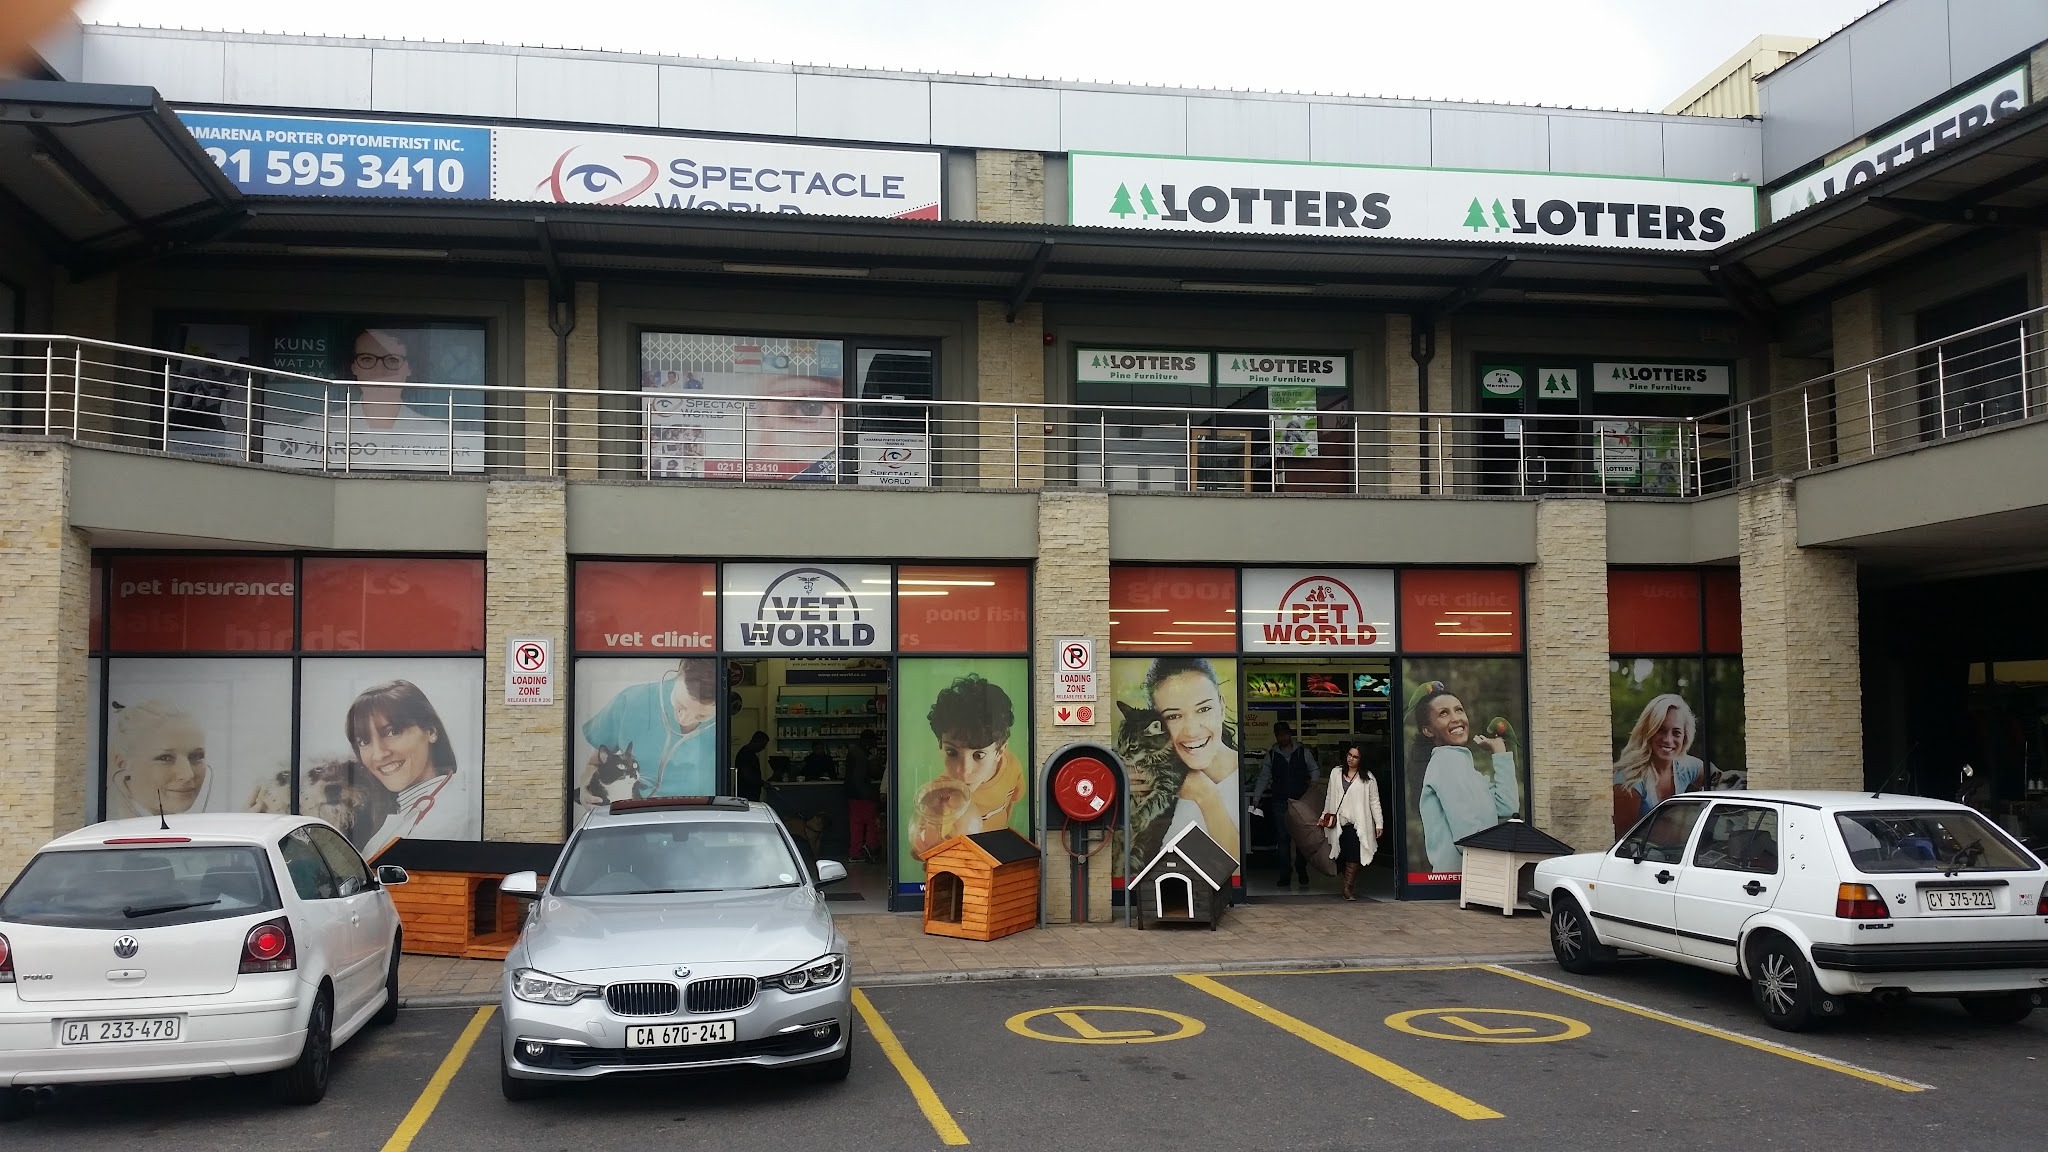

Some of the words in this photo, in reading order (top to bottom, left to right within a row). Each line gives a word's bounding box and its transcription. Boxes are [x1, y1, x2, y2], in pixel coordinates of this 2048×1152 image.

[266, 130, 323, 146] PORTER
[326, 134, 431, 151] OPTOMETRIST
[433, 138, 465, 152] INC.
[266, 150, 345, 188] 595
[356, 154, 465, 193] 3410
[668, 158, 906, 200] SPECTACLE
[1161, 183, 1392, 230] LOTTERS
[1511, 198, 1726, 243] LOTTERS
[274, 337, 326, 351] KUNS
[273, 358, 304, 368] WAT
[308, 359, 325, 369] JY
[1110, 355, 1196, 371] LOTTERS
[1250, 358, 1334, 375] LOTTERS
[1110, 371, 1132, 380] Pine
[1135, 372, 1179, 381] Furniture
[1273, 375, 1316, 384] Furniture
[1628, 367, 1707, 382] LOTTERS
[1628, 383, 1649, 391] Pine
[1651, 384, 1691, 392] Furniture
[717, 462, 734, 471] 021
[736, 463, 754, 472] 55
[755, 463, 779, 472] 3410
[120, 579, 162, 598] pet
[171, 578, 294, 596] insurance
[1414, 592, 1448, 607] vet
[1455, 592, 1508, 607] clinic
[771, 597, 845, 621] VET
[926, 606, 979, 623] pond
[1292, 603, 1349, 624] PET
[604, 631, 643, 648] vet
[651, 630, 712, 648] clinic
[740, 622, 875, 647] WORLD
[1263, 624, 1377, 646] WORLD
[512, 676, 547, 685] LOADING
[1060, 674, 1091, 683] LOADING
[519, 687, 541, 696] ZONE
[1066, 684, 1086, 693] ZONE
[1928, 892, 1944, 908] CY
[1949, 891, 1993, 908] 375-221
[23, 973, 54, 981] POLO
[68, 1022, 89, 1041] CA
[100, 1020, 175, 1040] 233-478
[637, 1028, 655, 1045] CA
[662, 1023, 727, 1044] 670-241
